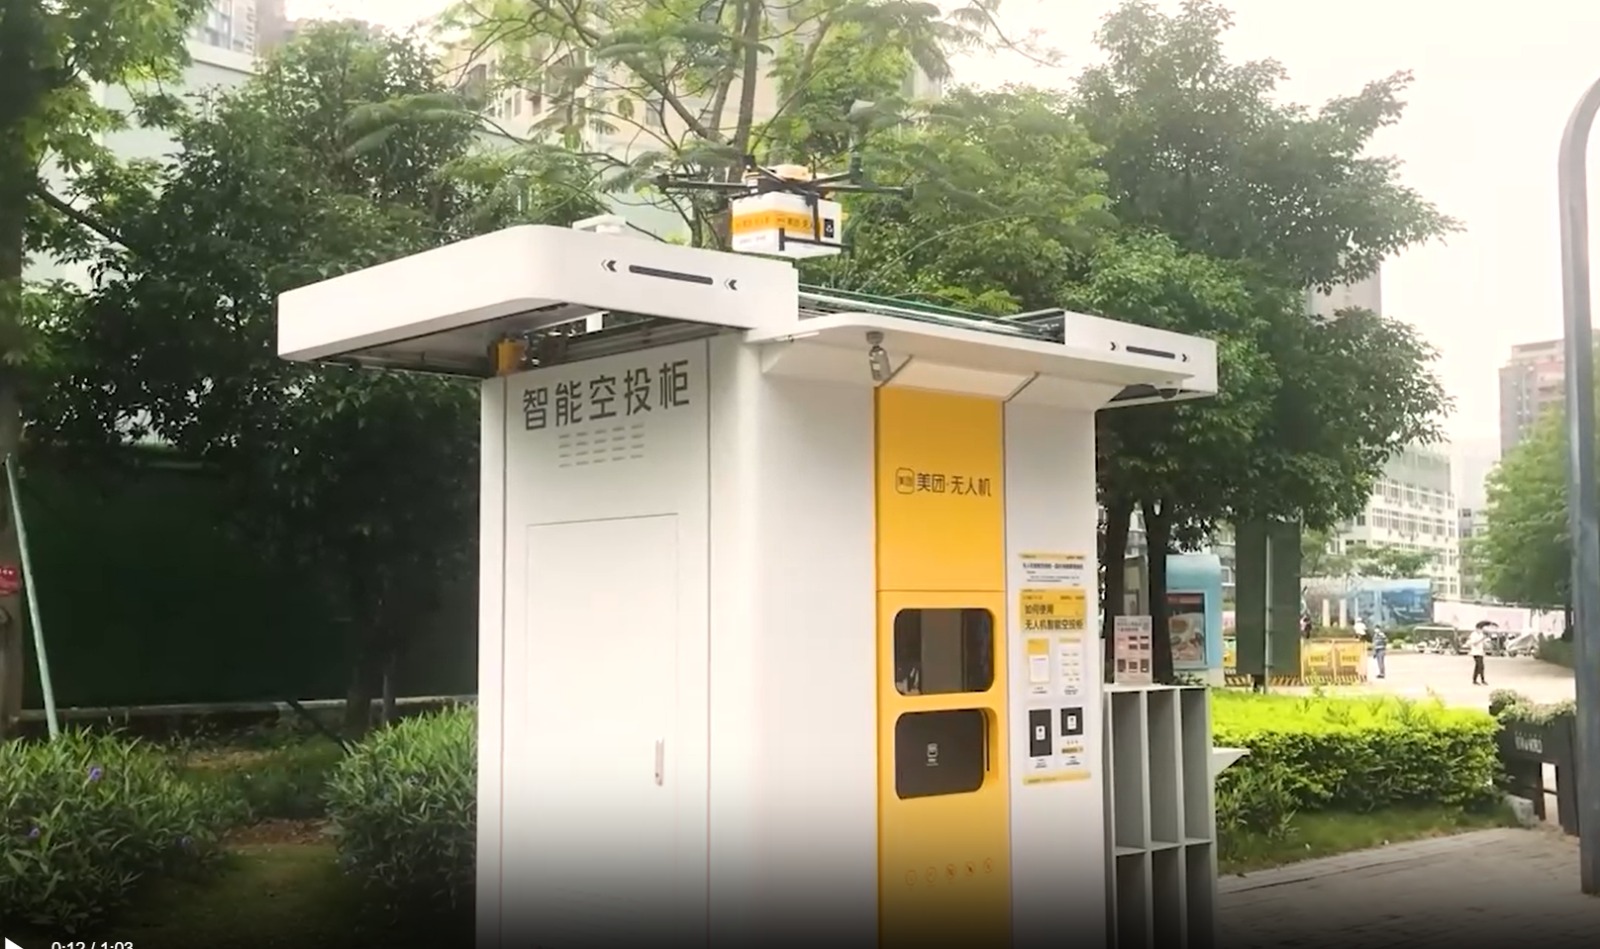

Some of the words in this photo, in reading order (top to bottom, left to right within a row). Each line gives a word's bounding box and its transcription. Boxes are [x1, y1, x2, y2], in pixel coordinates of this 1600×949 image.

[523, 360, 690, 431] 智能空投柜
[1025, 604, 1054, 615] 如何使用
